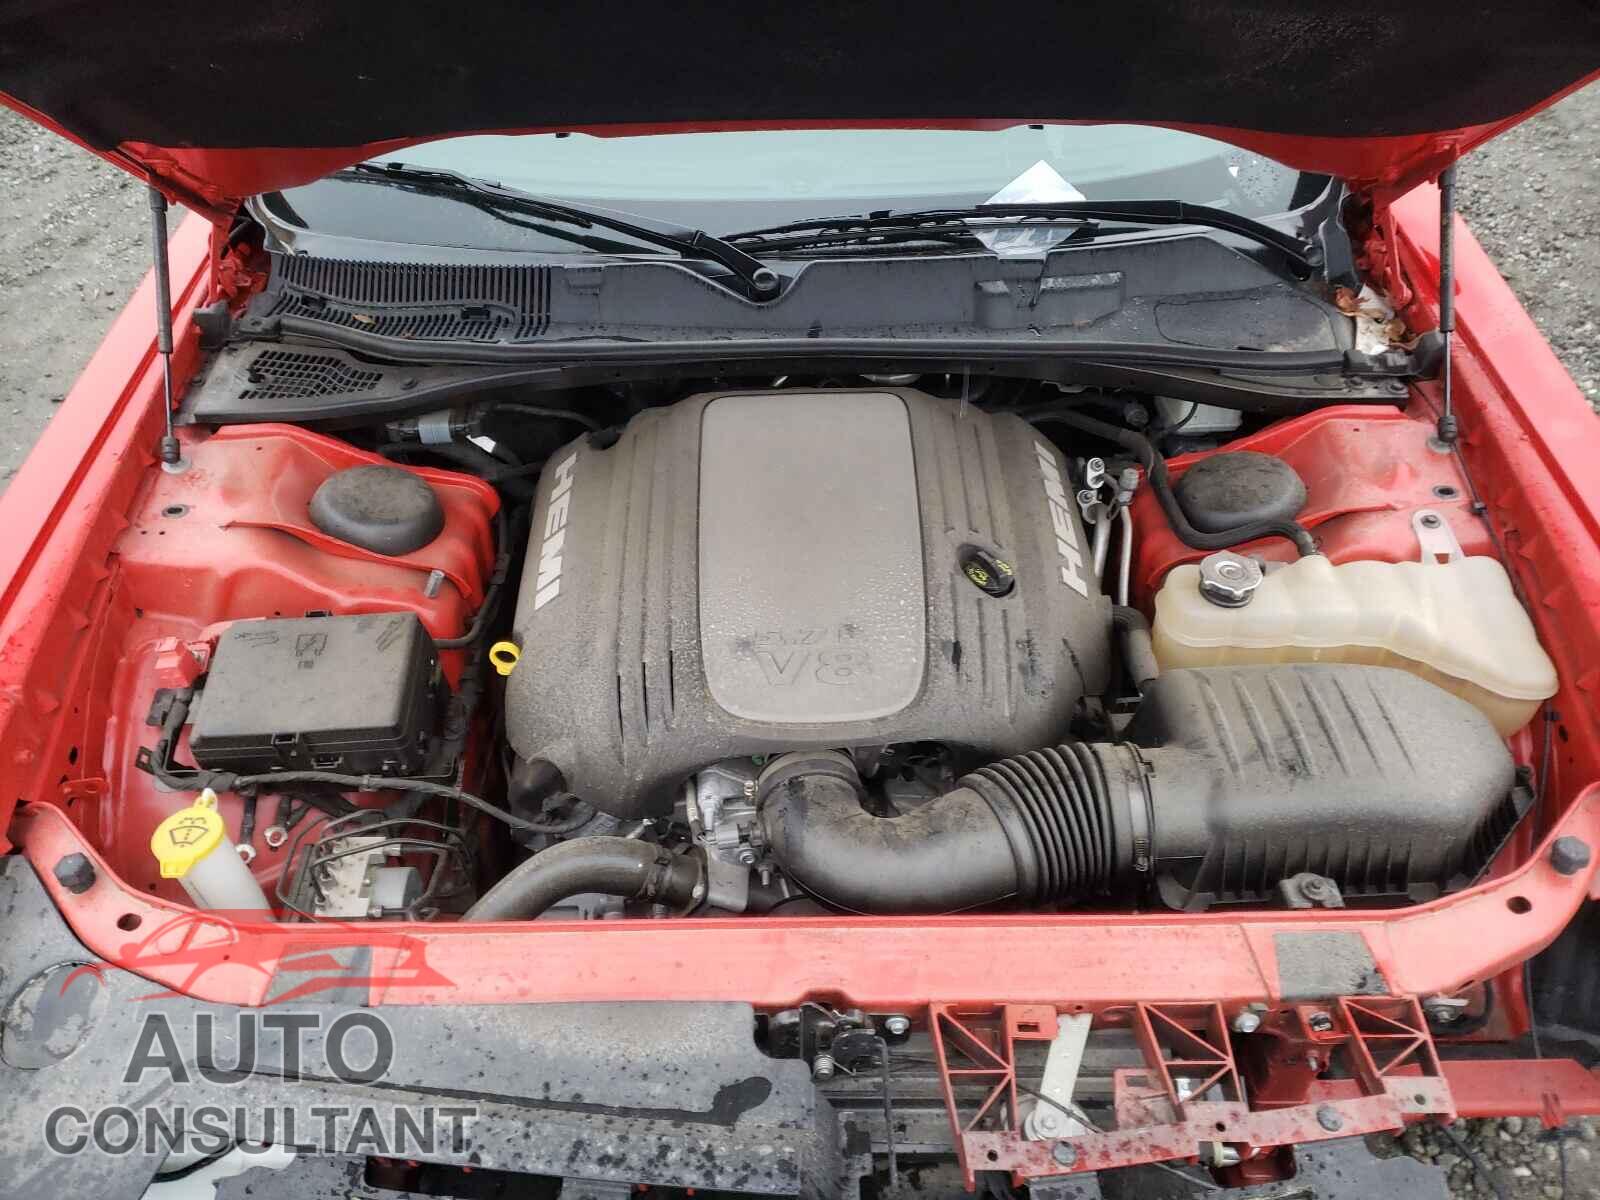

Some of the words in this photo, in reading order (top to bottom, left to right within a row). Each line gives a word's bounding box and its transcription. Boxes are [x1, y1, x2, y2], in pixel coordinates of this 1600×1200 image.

[534, 452, 577, 610] HEMI
[1034, 440, 1089, 599] HEMI
[751, 650, 873, 687] V8
